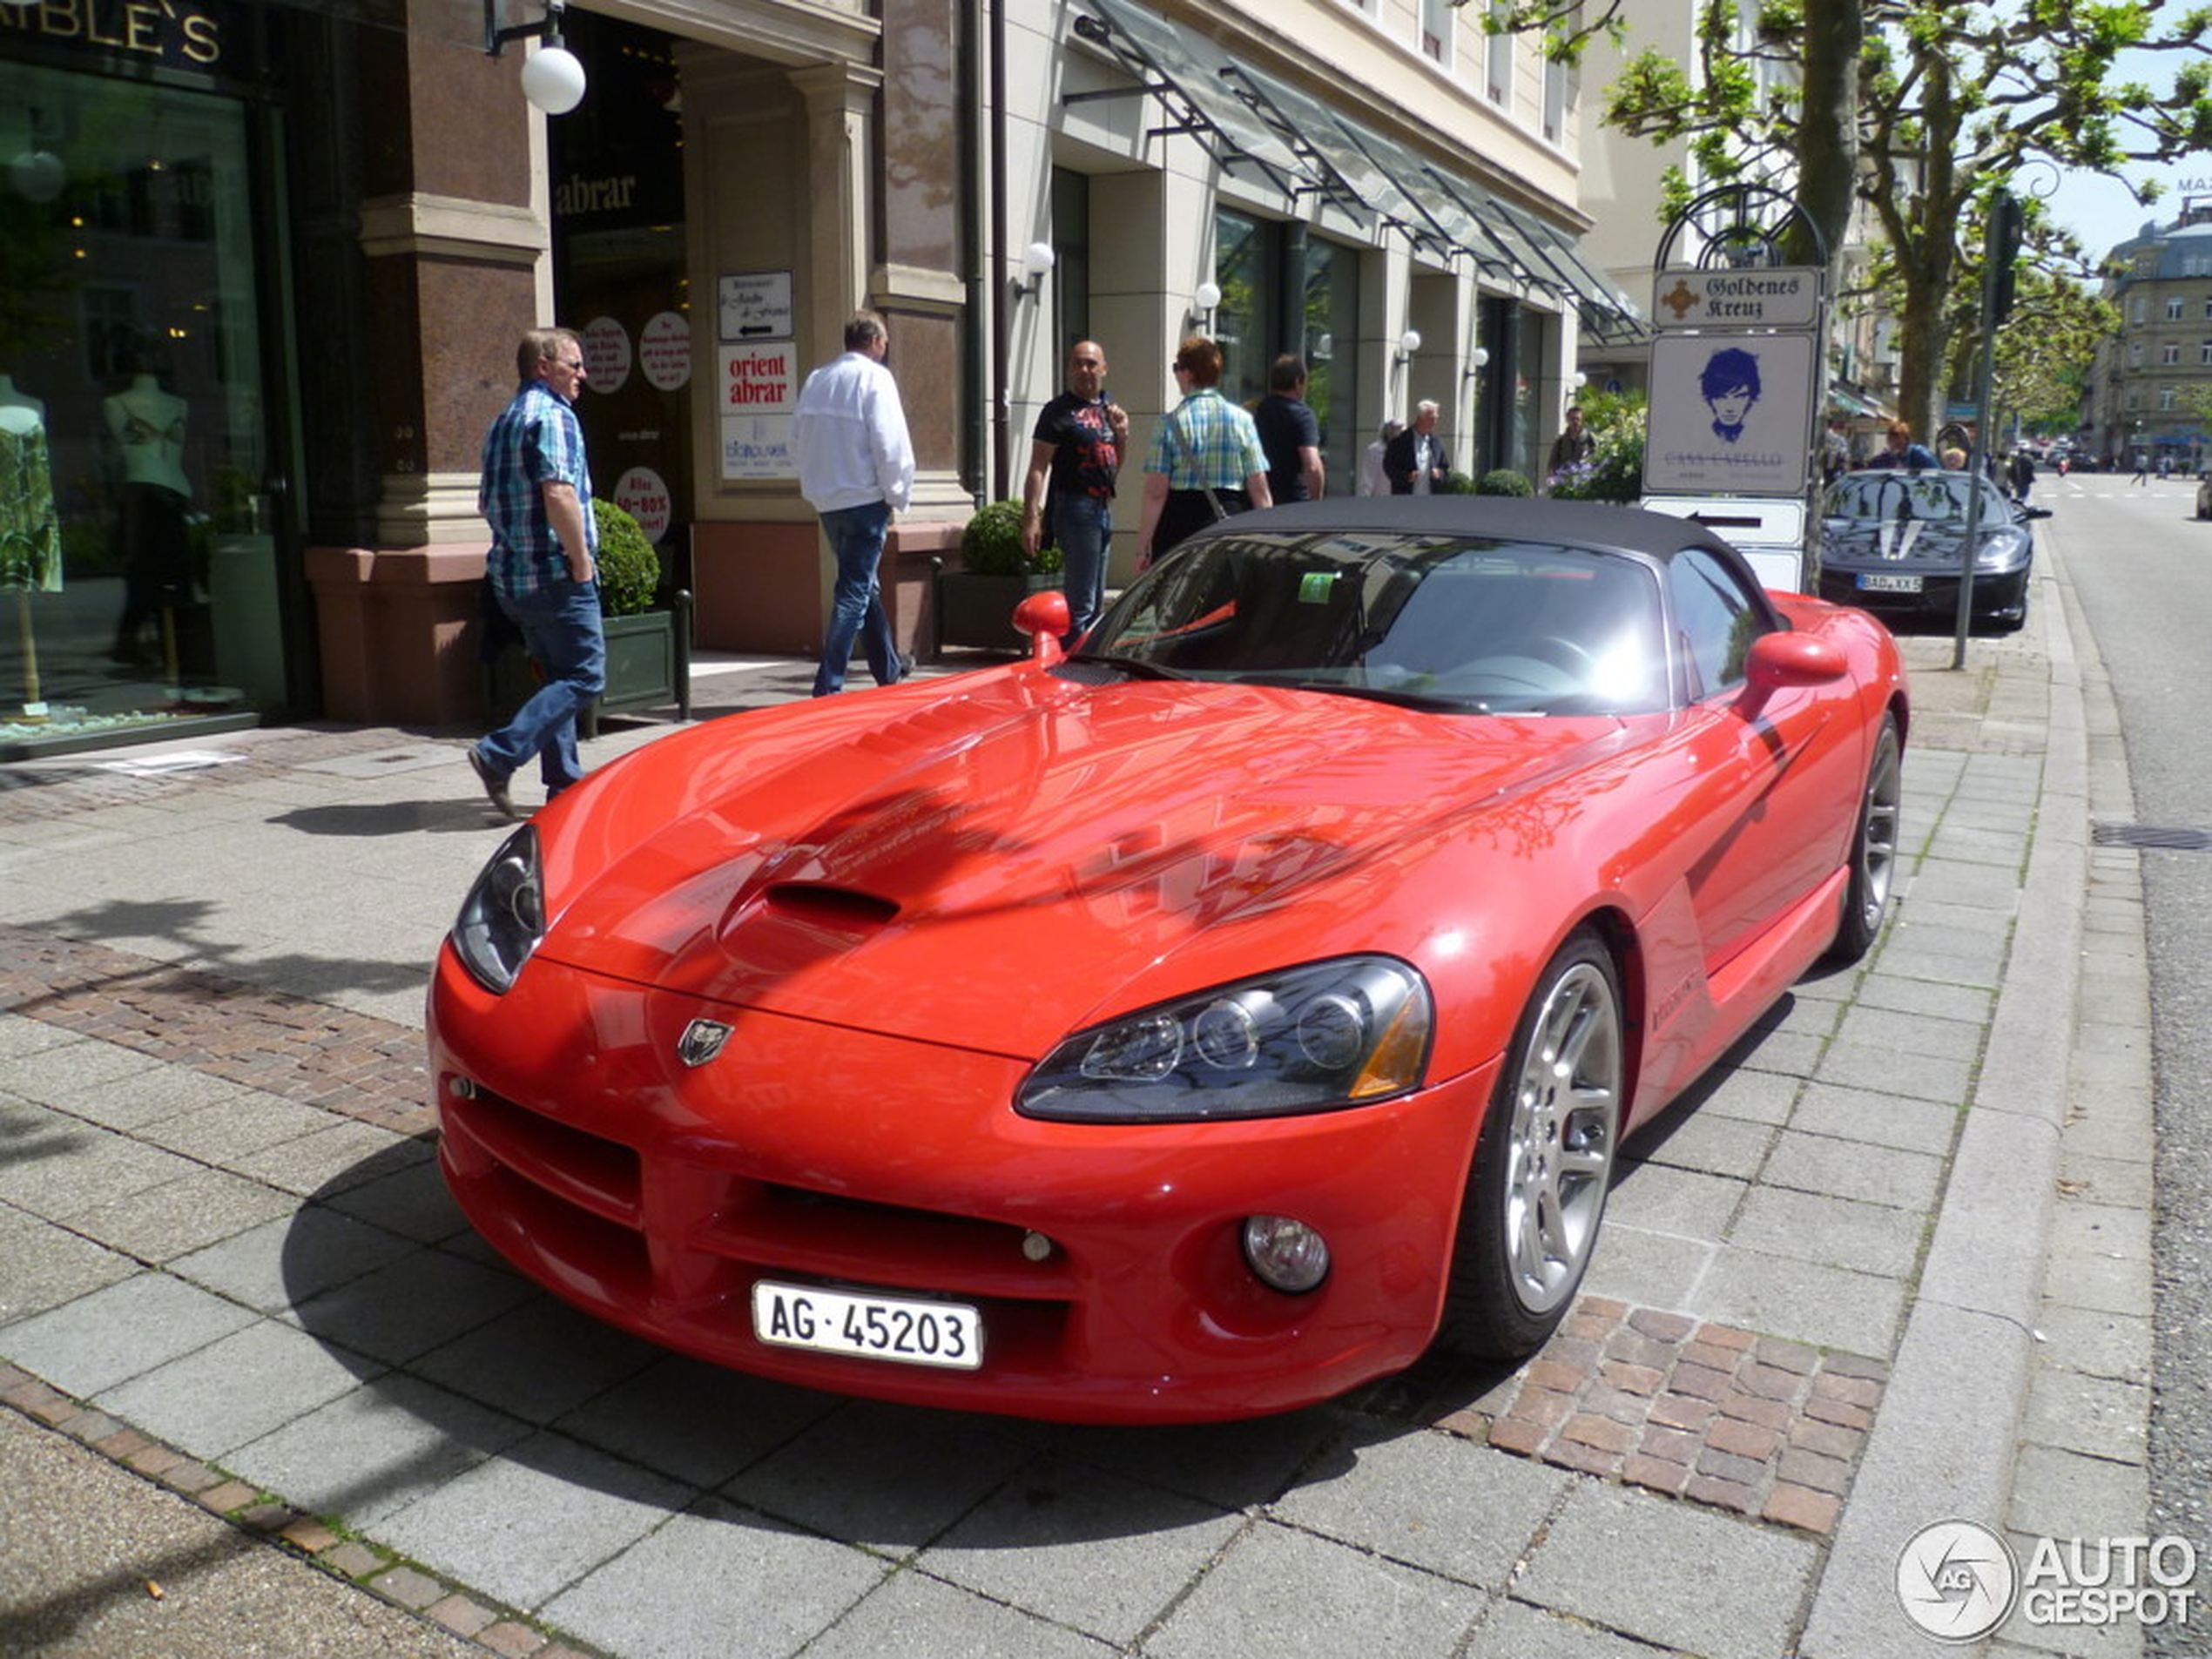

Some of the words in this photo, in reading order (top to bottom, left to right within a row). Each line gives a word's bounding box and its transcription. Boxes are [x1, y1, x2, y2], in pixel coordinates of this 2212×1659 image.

[557, 174, 636, 214] abrar
[1707, 279, 1799, 296] Goldenes
[1706, 300, 1763, 319] Kreuz
[729, 353, 786, 377] orient
[730, 379, 787, 404] abrar
